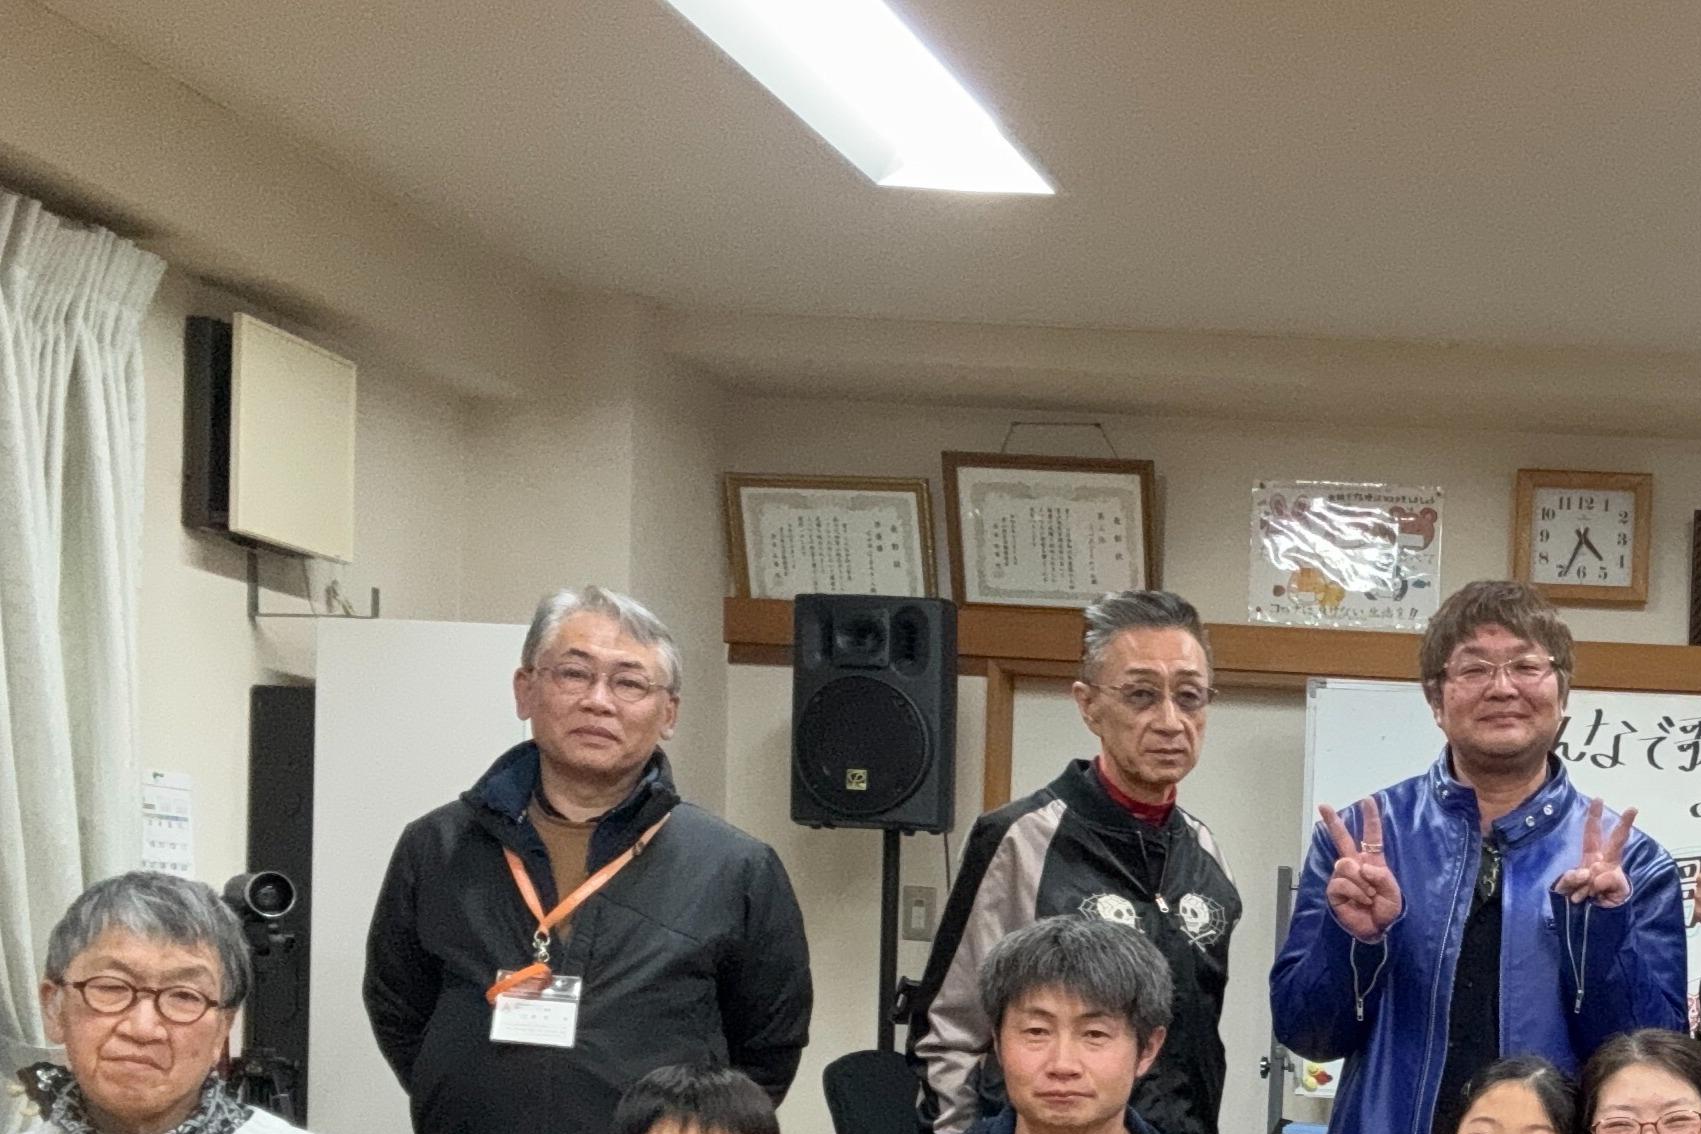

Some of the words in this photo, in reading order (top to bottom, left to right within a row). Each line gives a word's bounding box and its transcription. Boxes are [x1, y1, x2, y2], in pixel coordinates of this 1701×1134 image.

[1559, 496, 1571, 510] 11
[1578, 496, 1594, 510] 12
[1604, 499, 1609, 512] 1
[1541, 507, 1556, 520] 10
[1618, 511, 1628, 524] 2
[1540, 529, 1550, 542] 9
[1616, 533, 1628, 546] 3
[1539, 552, 1549, 565] 8
[1577, 566, 1587, 579] 6
[1599, 566, 1608, 580] 5
